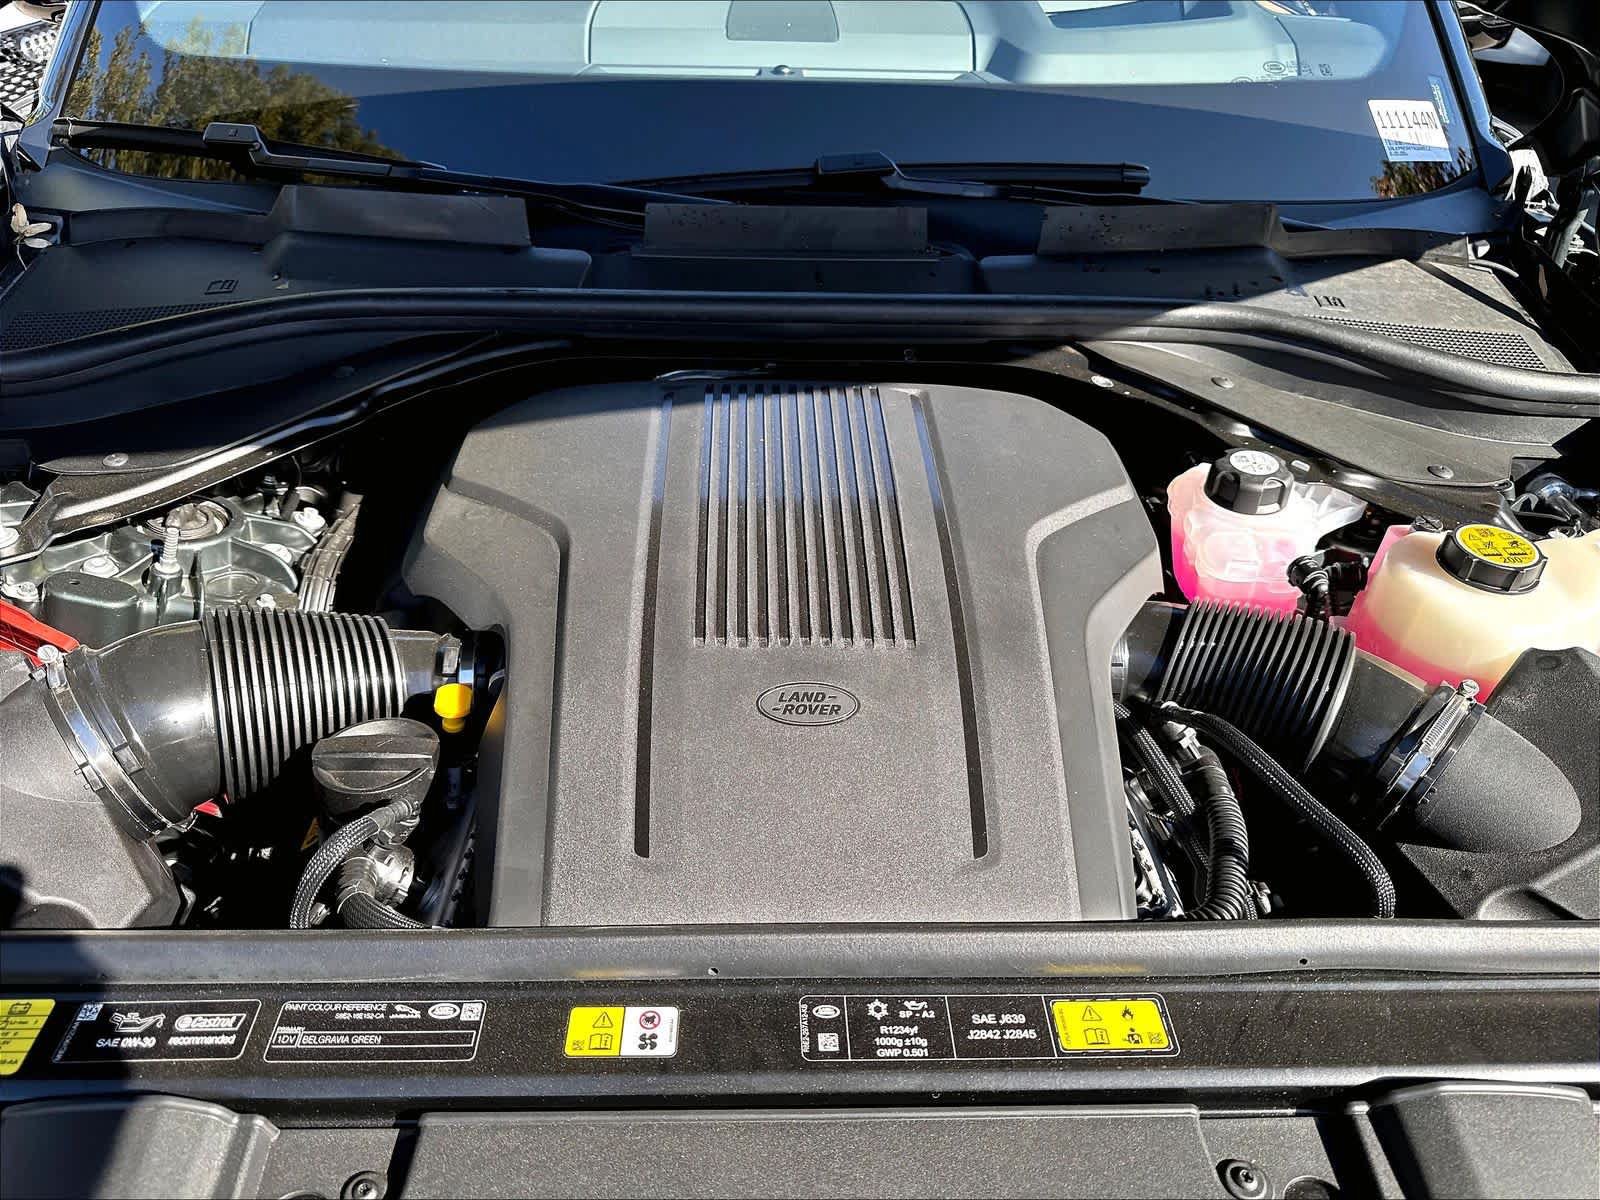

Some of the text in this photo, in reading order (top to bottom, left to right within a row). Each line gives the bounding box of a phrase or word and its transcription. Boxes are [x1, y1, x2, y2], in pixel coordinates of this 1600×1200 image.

[342, 1003, 387, 1011] REFERENCE
[899, 1010, 912, 1019] SP
[921, 1010, 935, 1019] A2
[971, 1014, 997, 1024] SAE
[191, 1016, 237, 1028] Castrol
[880, 1026, 919, 1035] R1234yf
[967, 1029, 1037, 1040] J2842 J2845
[96, 1036, 157, 1048] SAE 0W-30
[167, 1034, 237, 1046] recommended
[277, 1034, 382, 1045] 1DV BELGRAVIA GREEN
[875, 1037, 928, 1047] 1000g ±10g
[876, 1048, 929, 1057] GWP 0.501
